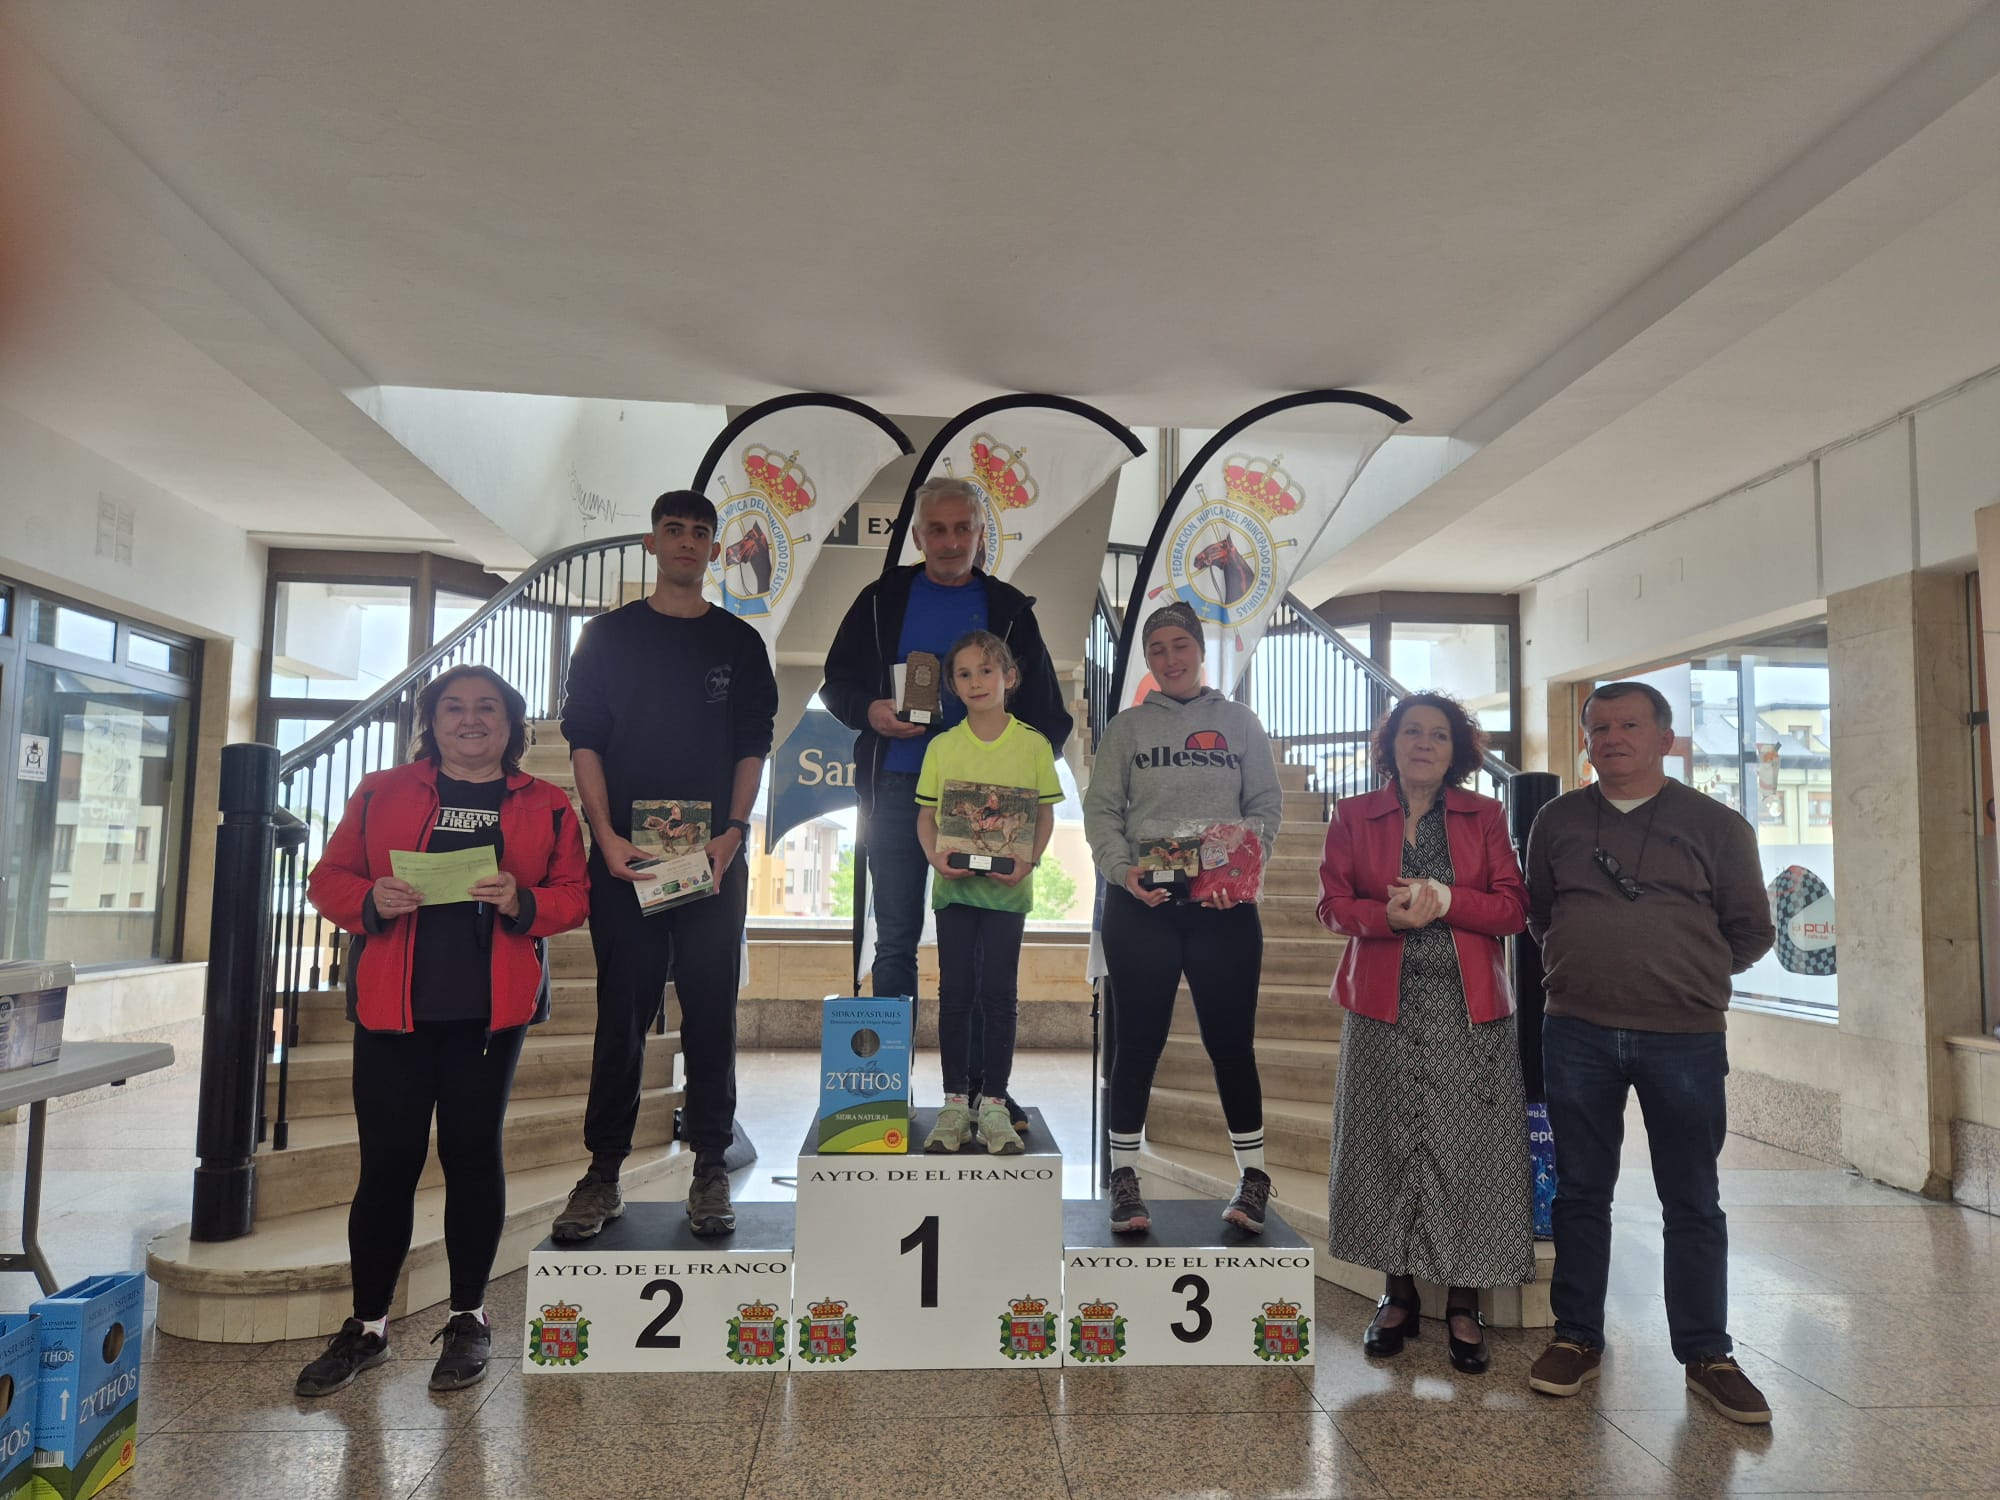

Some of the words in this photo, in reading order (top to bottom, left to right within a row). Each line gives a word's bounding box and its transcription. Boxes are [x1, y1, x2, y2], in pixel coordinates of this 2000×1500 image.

[1225, 508, 1239, 523] DEL
[1240, 516, 1271, 565] PRINCIPADO
[1261, 566, 1271, 579] DE
[1235, 579, 1268, 617] ASTURIAS
[1135, 746, 1241, 770] ellesse
[443, 810, 499, 822] ELECTRO
[825, 1072, 902, 1091] ZYTHOS
[811, 1170, 878, 1182] AYTO.
[888, 1170, 918, 1181] DE
[925, 1170, 951, 1181] EL
[958, 1169, 1053, 1181] FRANCO
[535, 1264, 607, 1277] AYTO.
[615, 1264, 647, 1276] DE
[654, 1264, 681, 1276] EL
[688, 1262, 787, 1275] FRANCO
[901, 1216, 939, 1308] 1
[1070, 1257, 1138, 1268] AYTO.
[1146, 1257, 1176, 1268] DE
[1183, 1257, 1208, 1268] EL
[1215, 1257, 1310, 1268] FRANCO
[635, 1279, 684, 1349] 2
[1170, 1274, 1213, 1343] 3
[42, 1350, 74, 1362] THOS
[79, 1367, 137, 1425] ZYTHOS
[0, 1421, 30, 1462] HOS
